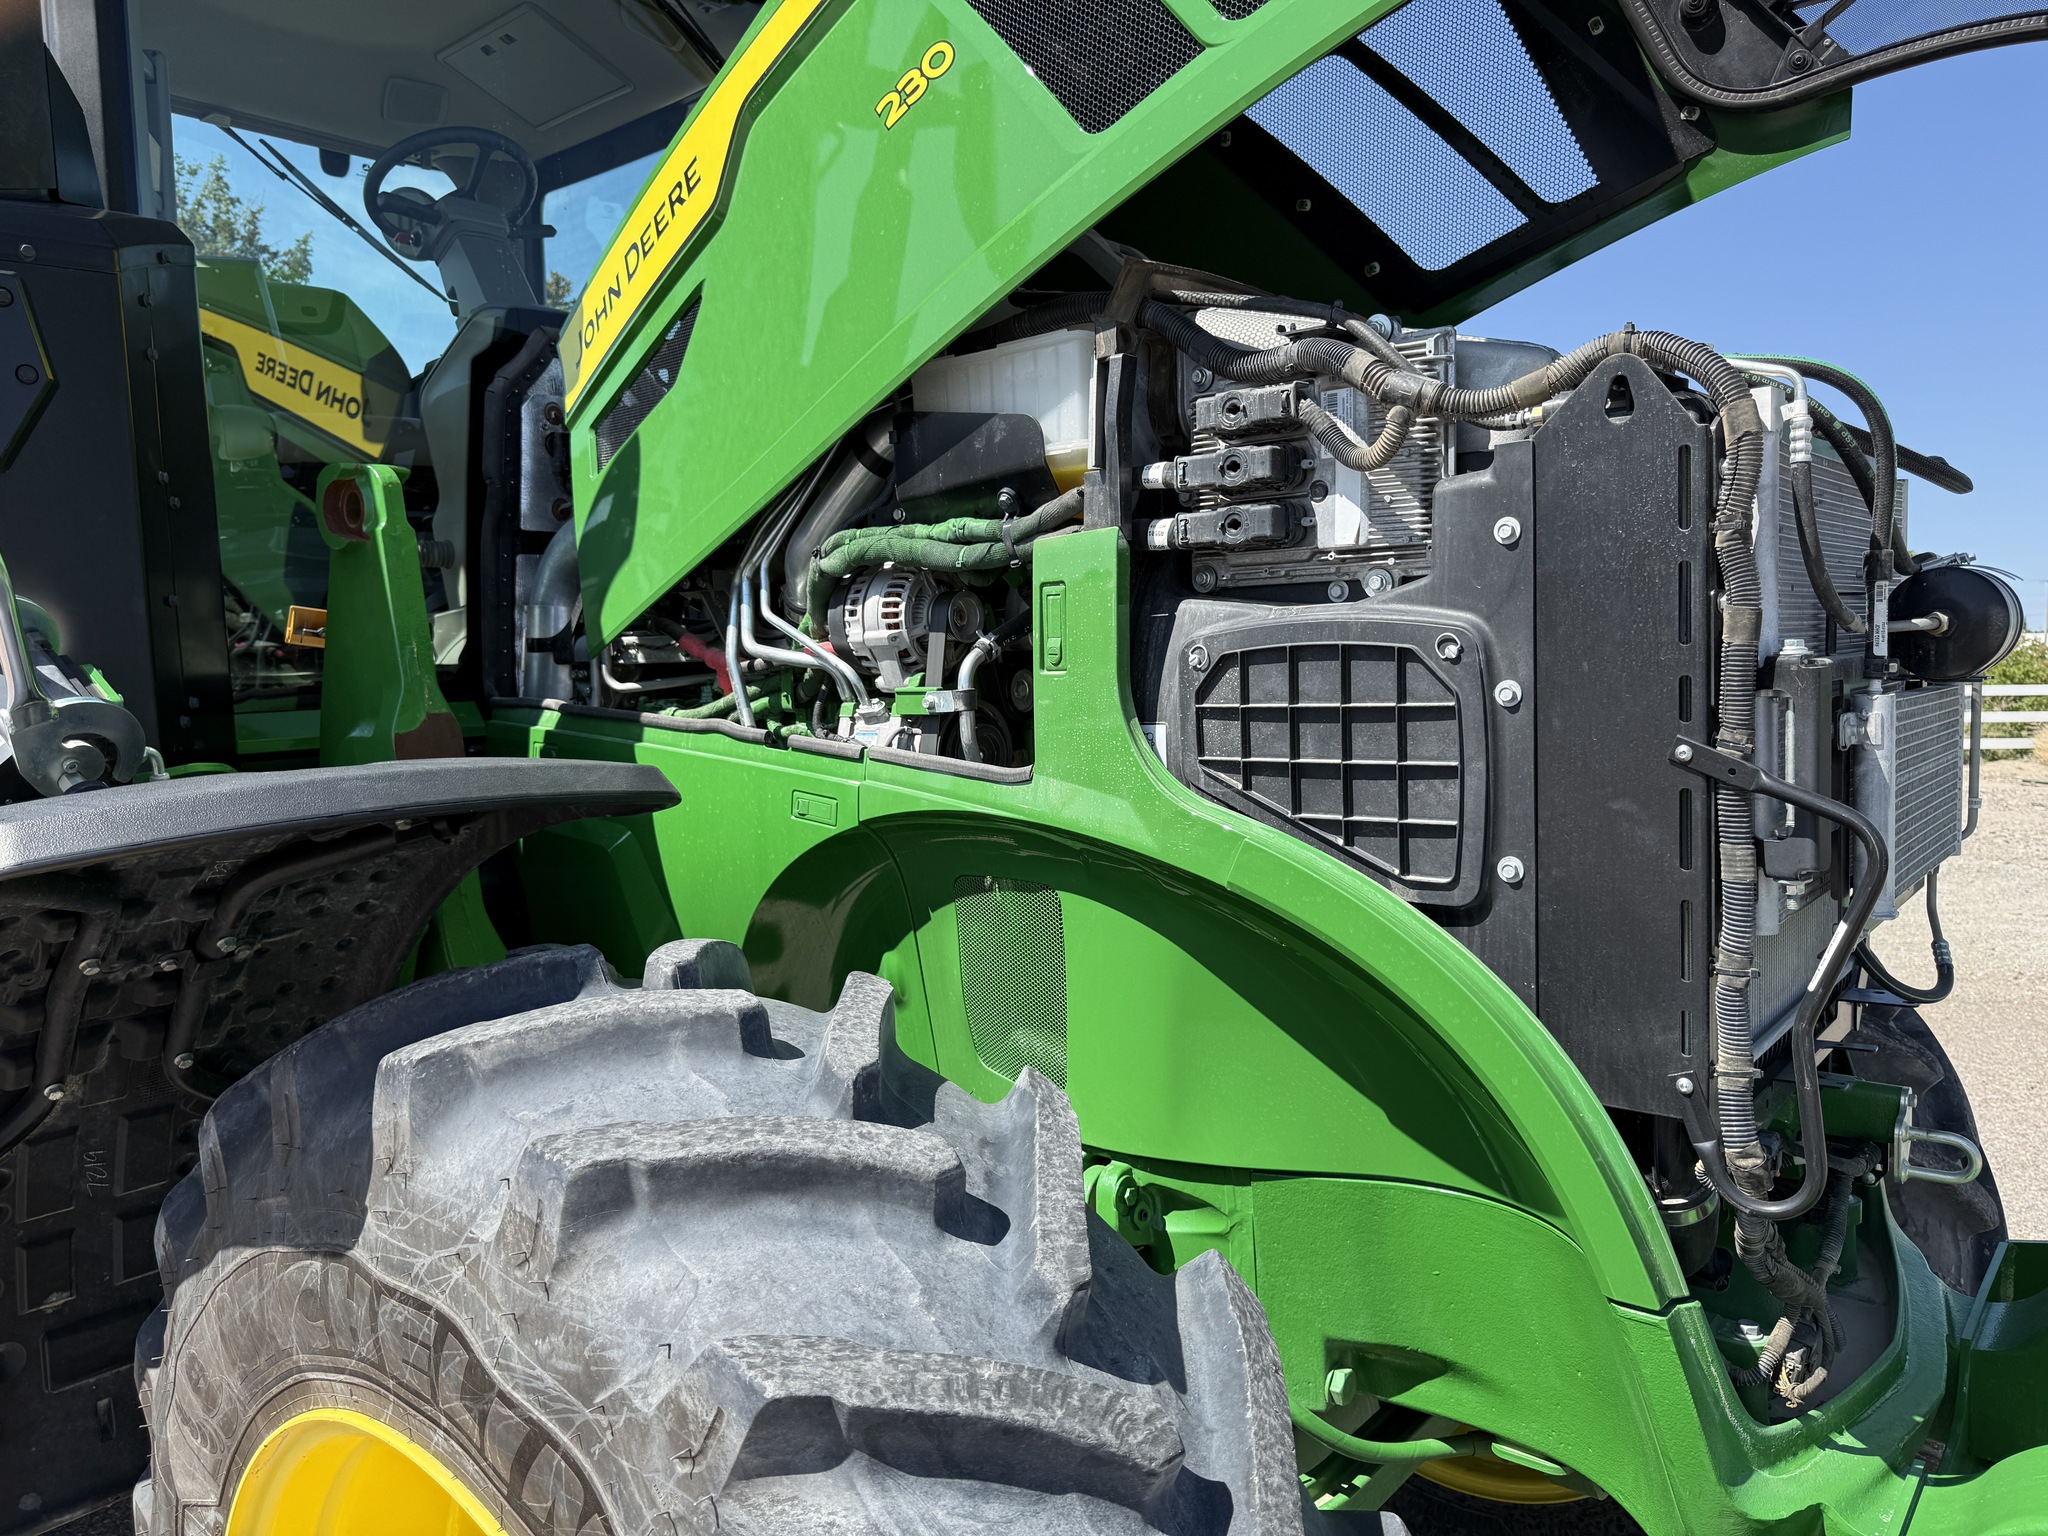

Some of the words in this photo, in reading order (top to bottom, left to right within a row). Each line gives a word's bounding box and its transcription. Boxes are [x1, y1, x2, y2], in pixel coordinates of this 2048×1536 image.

[874, 40, 956, 131] 230
[575, 272, 622, 370] JOHN
[623, 155, 702, 285] DEERE
[1841, 431, 1856, 449] ESP
